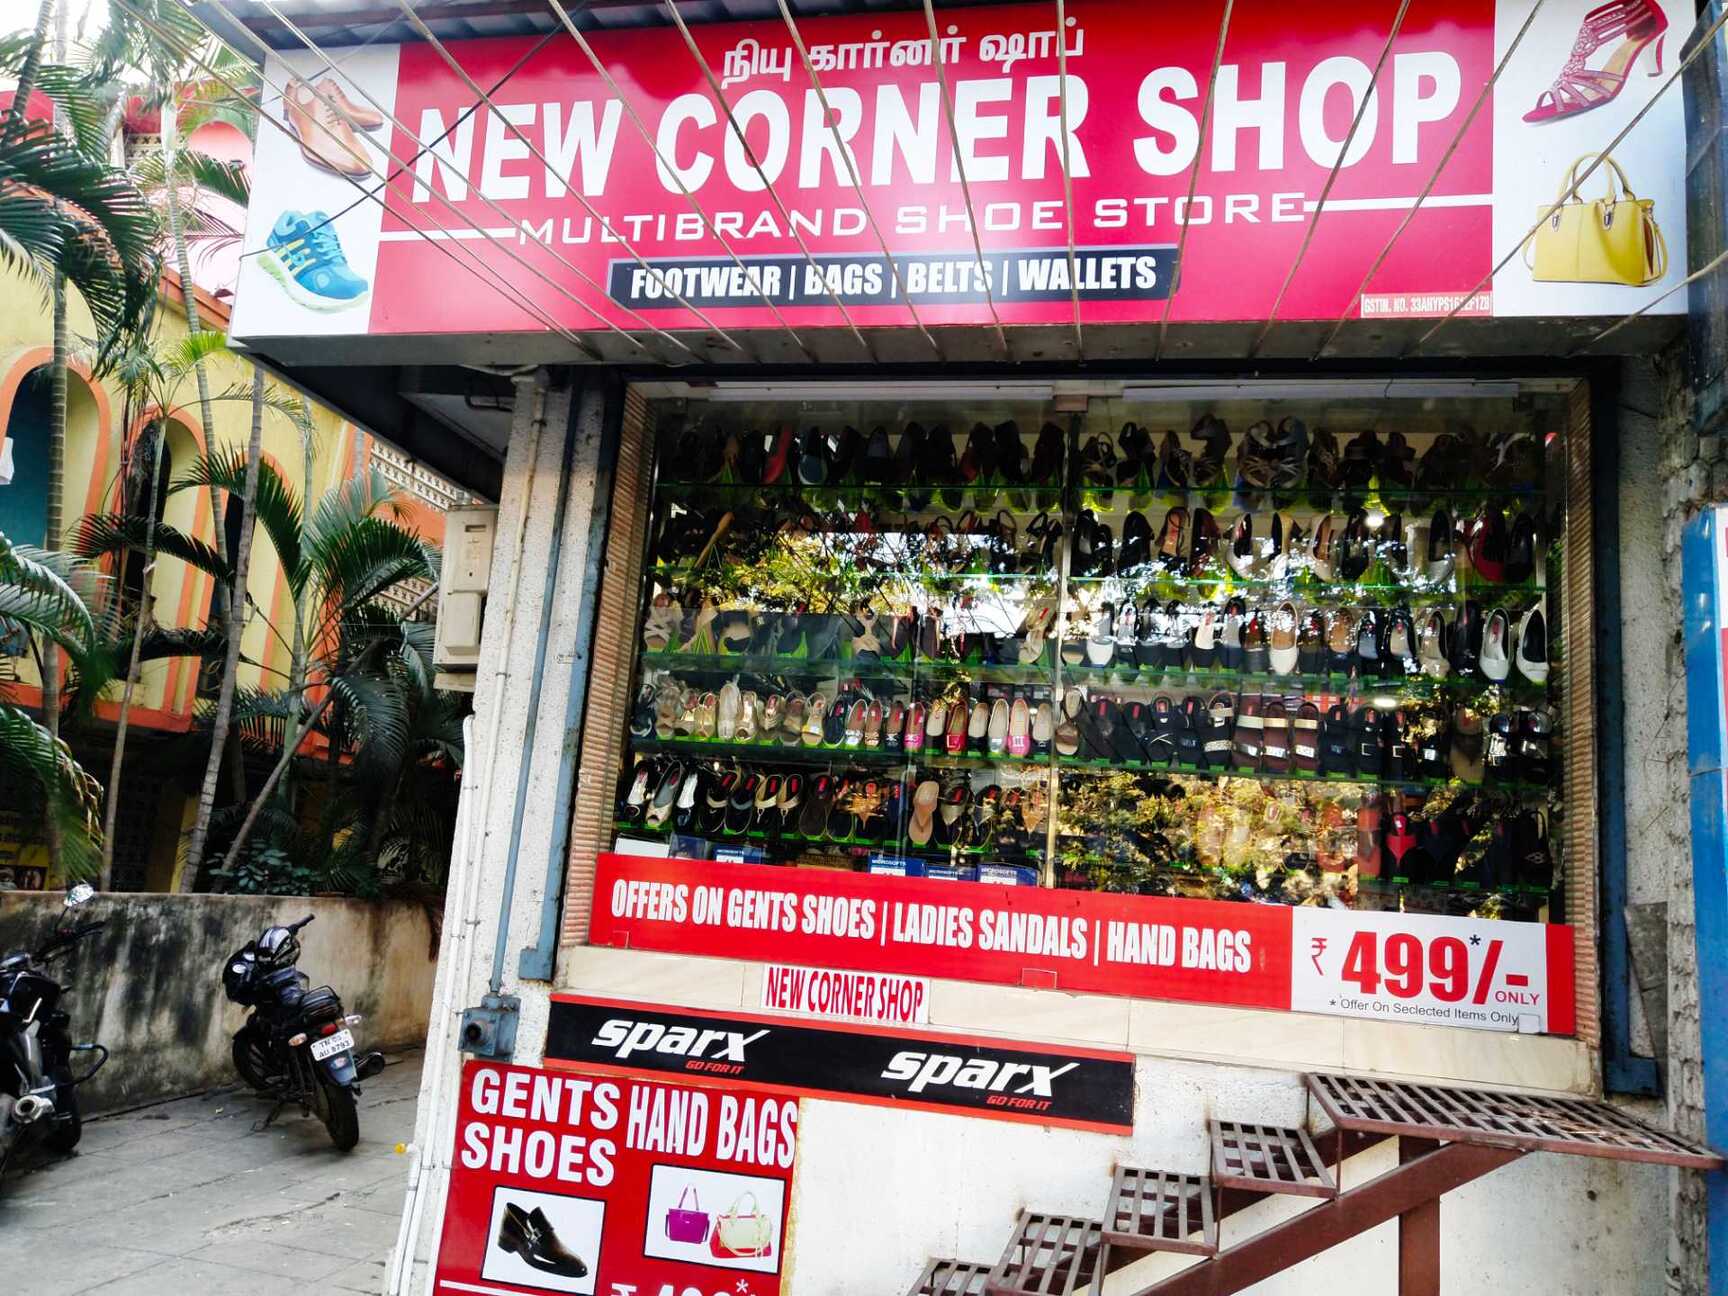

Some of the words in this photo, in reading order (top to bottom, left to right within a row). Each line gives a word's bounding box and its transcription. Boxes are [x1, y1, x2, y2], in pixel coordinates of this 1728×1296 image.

[412, 98, 622, 203] NEW
[654, 74, 1091, 193] CORNER
[1133, 51, 1461, 175] SHOP
[519, 208, 867, 245] MULTIBRAND
[895, 200, 1064, 232] SHOE
[1093, 192, 1305, 227] STORE
[631, 265, 781, 299] FOOTWEAR
[803, 262, 883, 296] BAGS
[906, 260, 993, 293] BELTS
[1019, 255, 1156, 290] WALLETS
[611, 880, 689, 922] OFFERS
[692, 886, 723, 926] ON
[727, 887, 796, 934] GENTS
[801, 894, 875, 941] SHOES
[893, 903, 973, 950] LADIES
[978, 910, 1087, 960] SANDALS
[1107, 920, 1176, 966] HAND
[1182, 927, 1251, 974] BAGS
[766, 967, 805, 1011] NEW
[808, 970, 875, 1018] CORNER
[878, 979, 923, 1023] SHOP
[1341, 998, 1369, 1012] Offer
[1372, 1000, 1390, 1013] On
[1393, 1003, 1450, 1018] Seclected
[1454, 1008, 1487, 1022] Items
[1490, 1011, 1518, 1026] Only
[1495, 990, 1540, 1006] ONLY
[592, 1019, 771, 1062] sparx
[685, 1060, 703, 1071] GO
[704, 1062, 729, 1073] FOR
[730, 1065, 744, 1075] IT
[880, 1051, 1080, 1097] sparx
[471, 1068, 621, 1131] GENTS
[987, 1095, 1008, 1105] GO
[1008, 1097, 1036, 1108] FOR
[1036, 1100, 1052, 1110] IT
[625, 1084, 711, 1158] HAND
[716, 1095, 798, 1170] BAGS
[461, 1121, 618, 1187] SHOES
